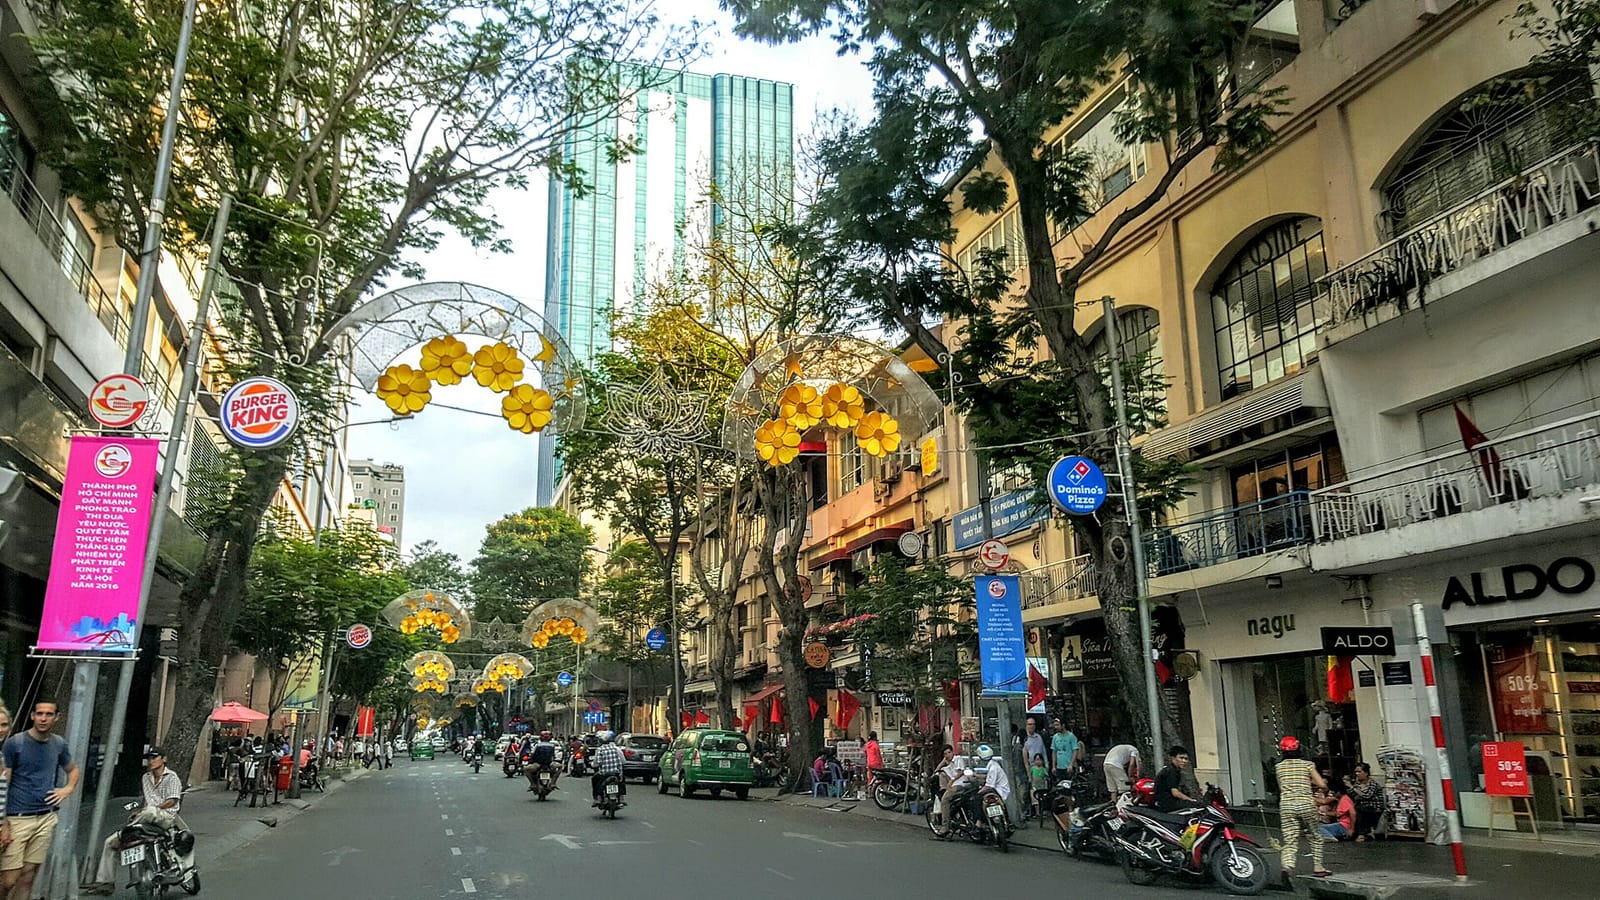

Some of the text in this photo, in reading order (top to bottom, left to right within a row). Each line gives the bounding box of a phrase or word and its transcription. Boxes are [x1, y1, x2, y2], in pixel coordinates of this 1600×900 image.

[231, 394, 287, 412] BURGER
[231, 405, 288, 428] KING
[1057, 485, 1103, 494] Domino's
[1068, 495, 1095, 504] Pizza
[1441, 556, 1596, 610] ALDO
[1247, 612, 1296, 639] nagu
[1334, 634, 1389, 649] ALDO
[1507, 675, 1538, 691] 50%
[1497, 761, 1523, 771] 50%
